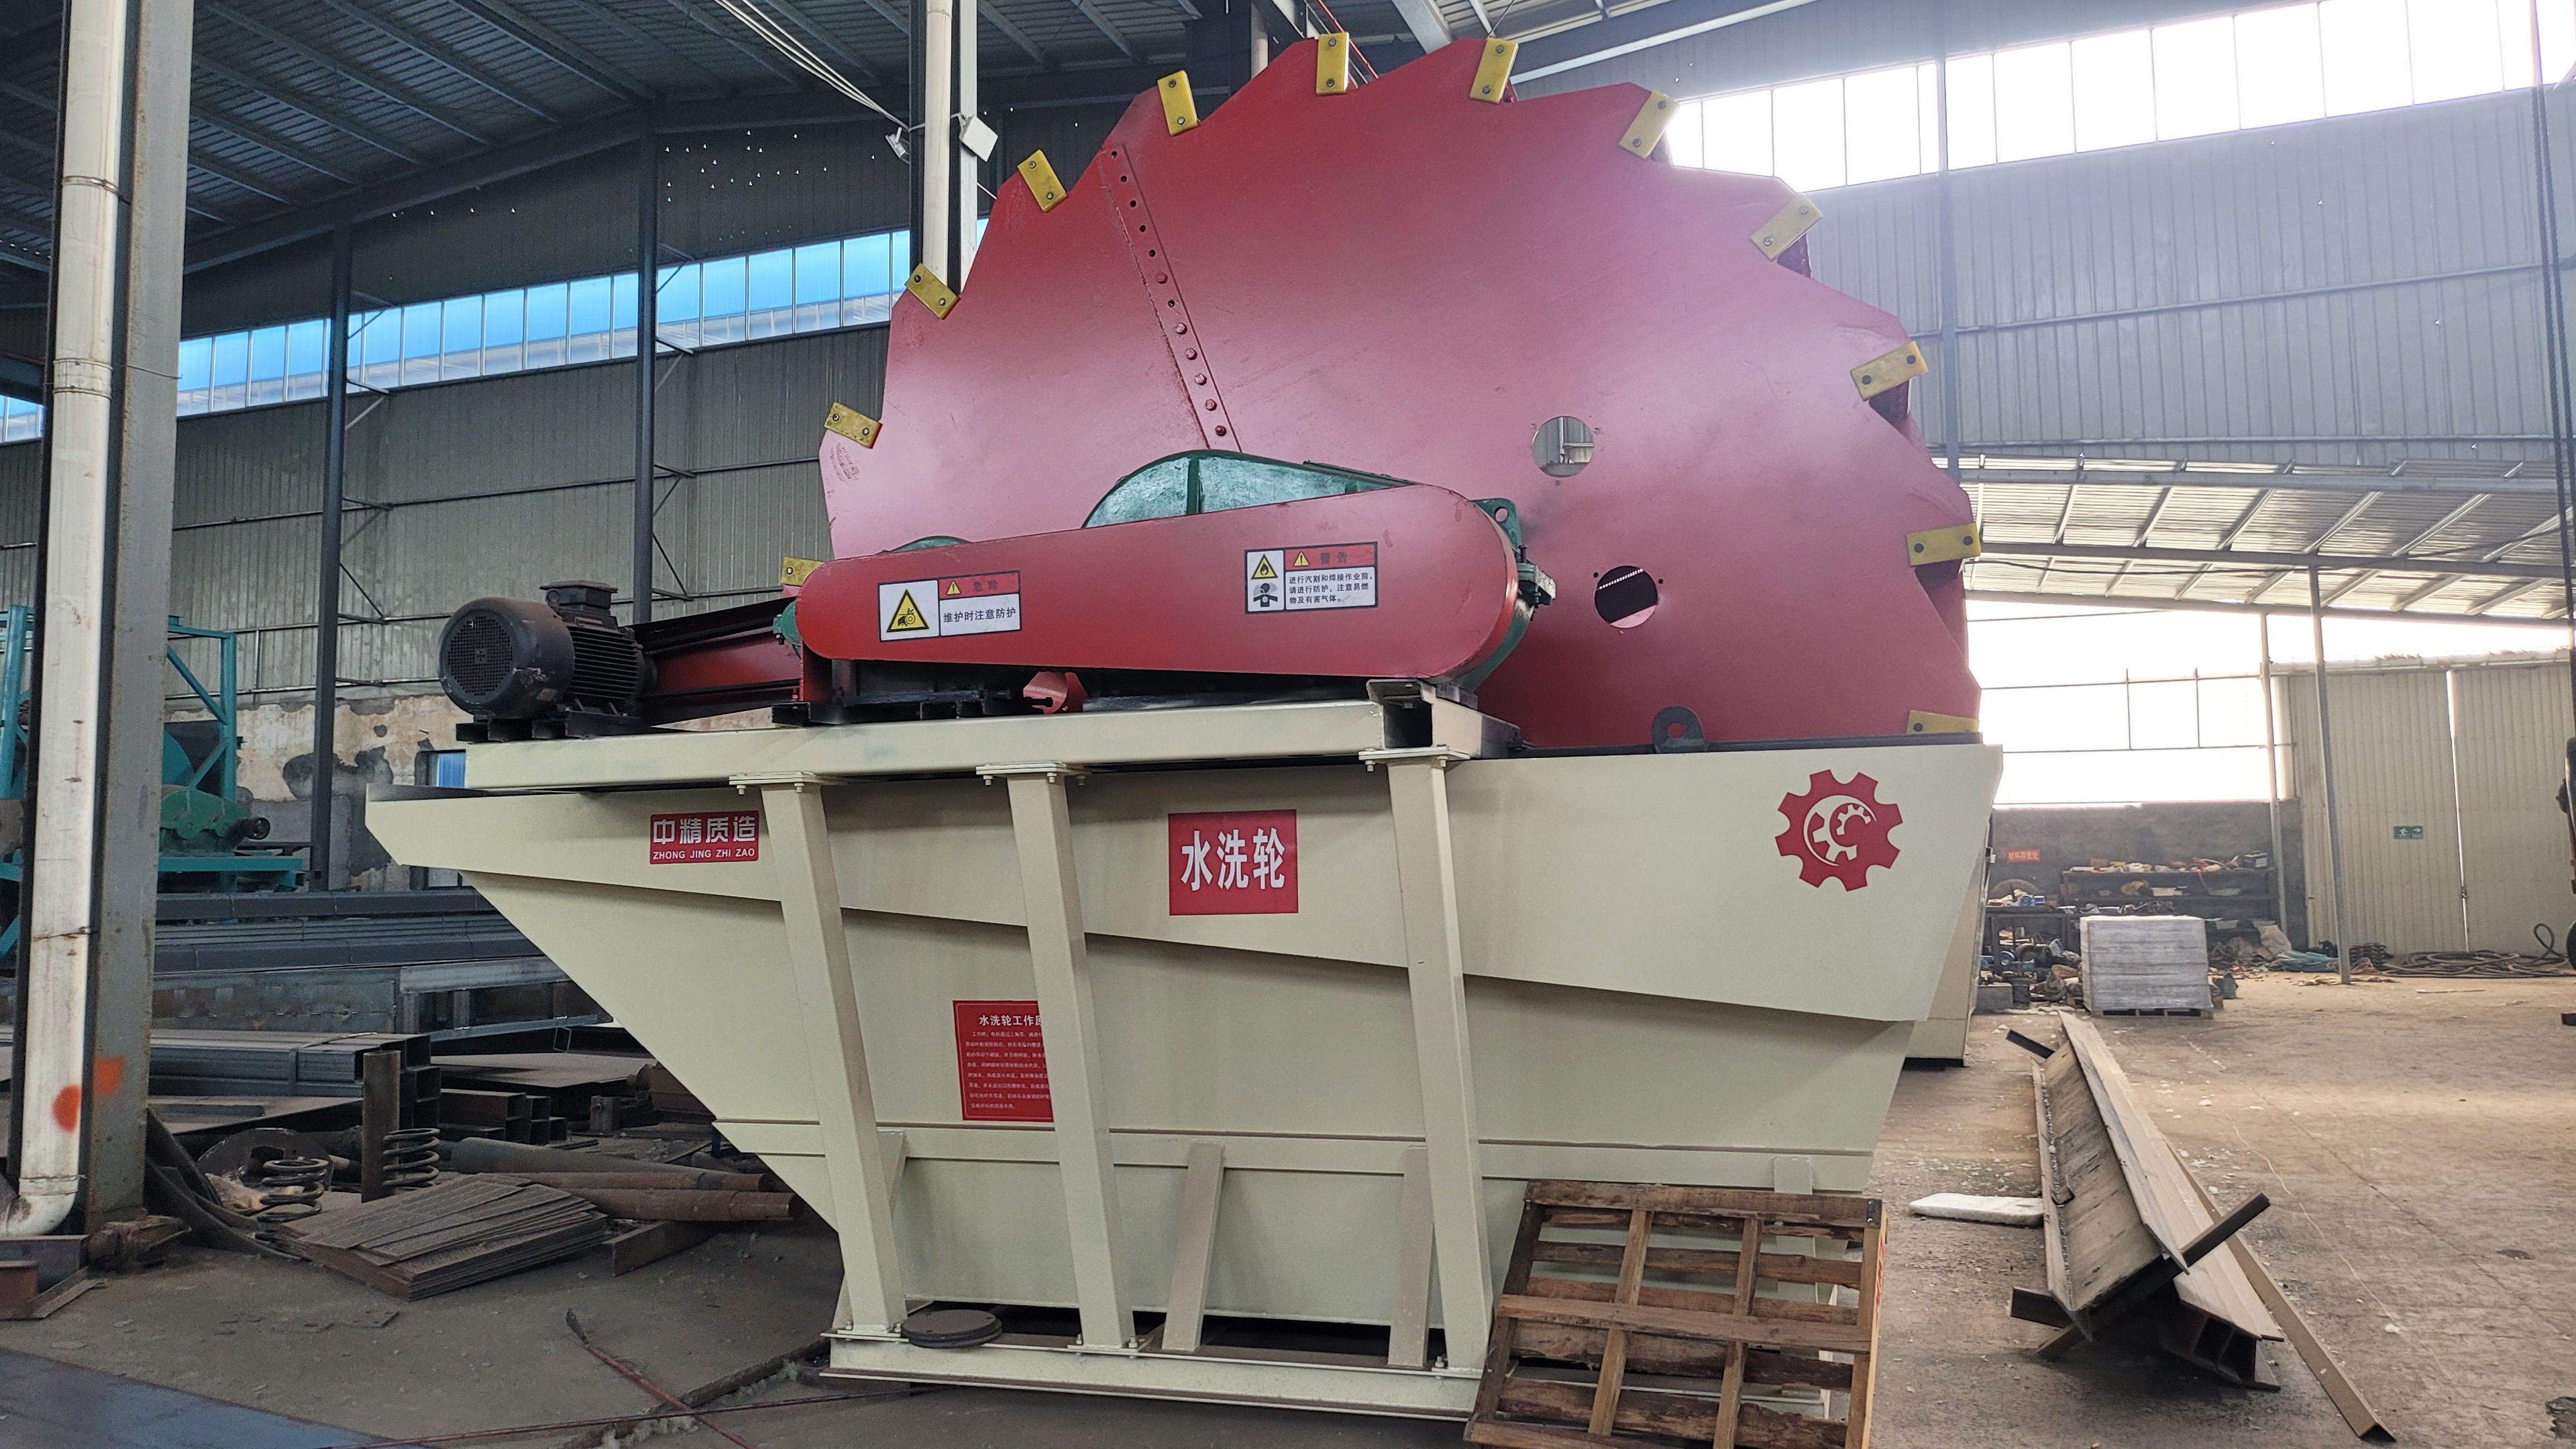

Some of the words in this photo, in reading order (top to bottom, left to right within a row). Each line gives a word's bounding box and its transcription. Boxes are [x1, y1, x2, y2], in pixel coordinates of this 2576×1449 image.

[1320, 551, 1348, 564] 警告
[973, 580, 998, 592] 危险
[943, 607, 1016, 623] 维护时注意防护
[653, 816, 756, 845] 中精质造
[653, 851, 686, 860] ZHONG
[690, 849, 712, 859] JING
[716, 849, 731, 857] ZHI
[735, 848, 755, 857] ZAO
[1181, 827, 1285, 891] 水洗轮
